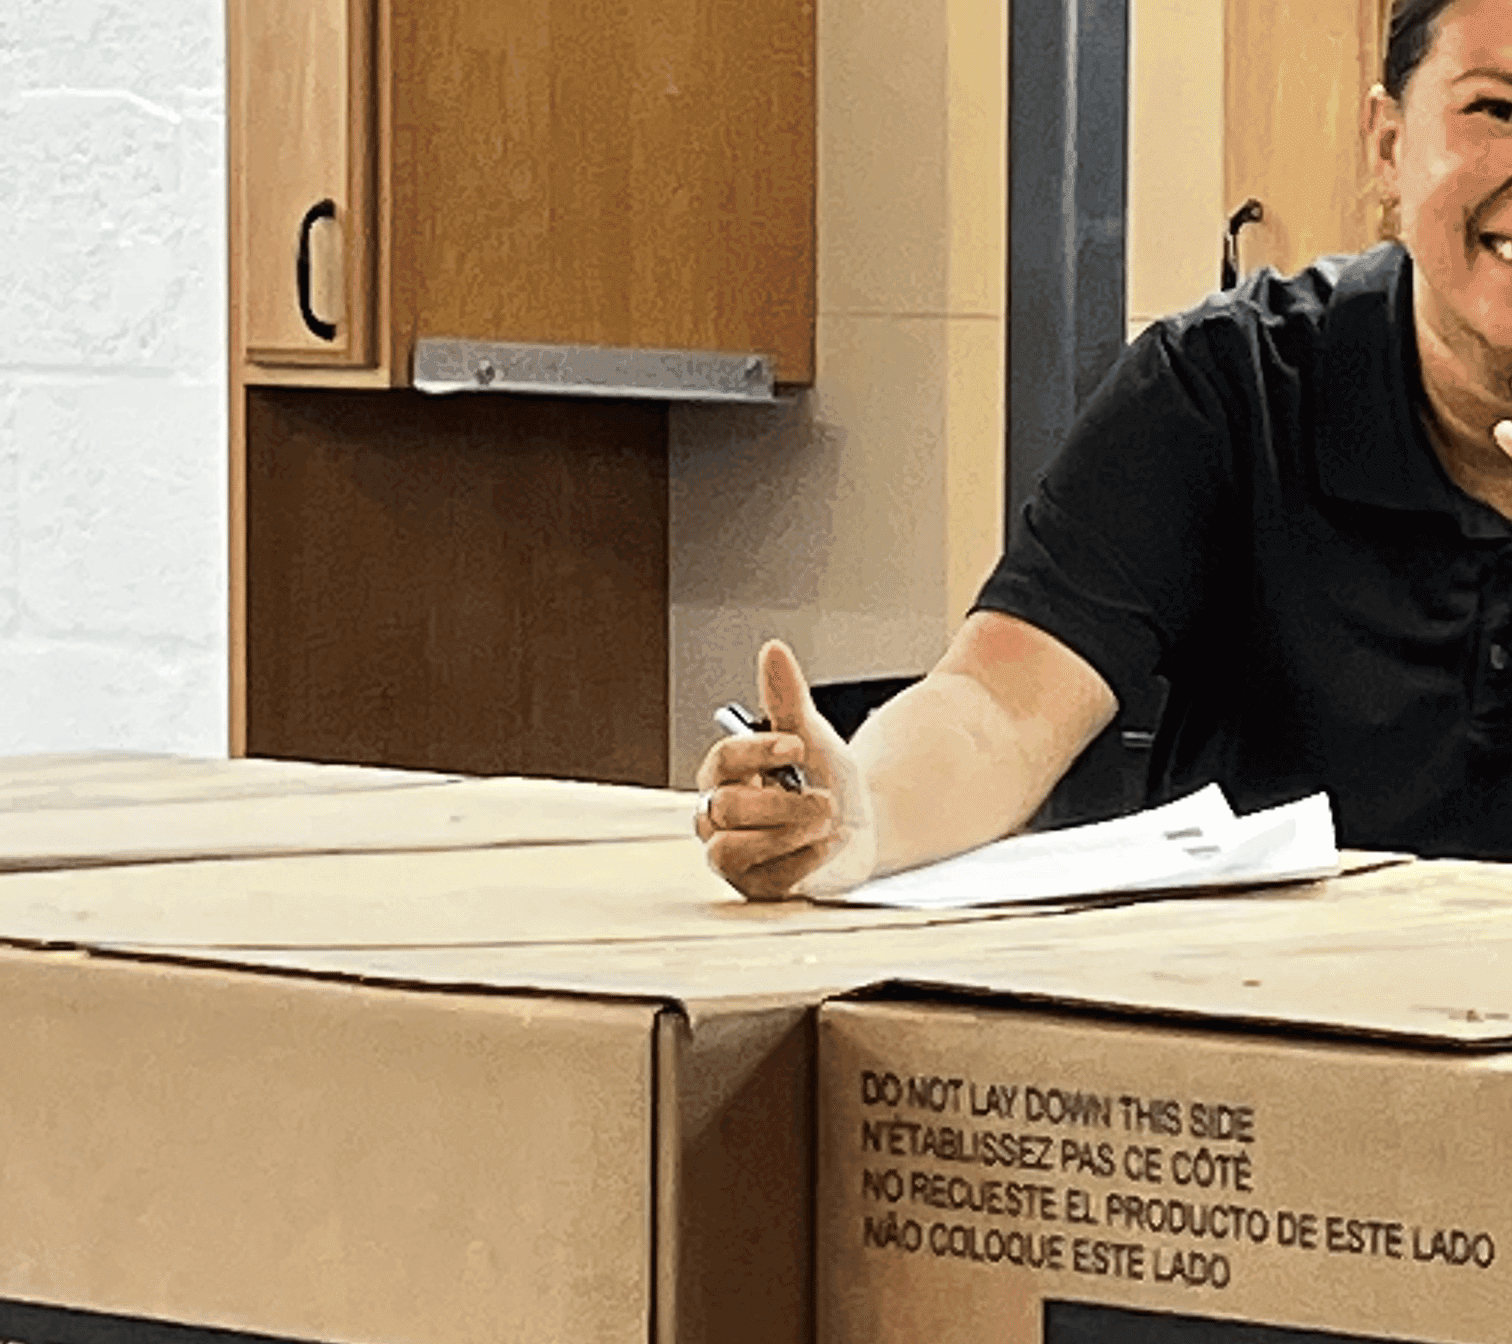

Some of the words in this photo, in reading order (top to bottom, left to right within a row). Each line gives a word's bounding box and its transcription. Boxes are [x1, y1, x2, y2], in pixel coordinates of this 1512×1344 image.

[861, 1070, 901, 1107] DO
[908, 1077, 963, 1113] NOT
[970, 1082, 1018, 1119] LAY
[1024, 1087, 1111, 1128] DOWN
[1118, 1096, 1183, 1136] THIS
[1190, 1102, 1255, 1142] SIDE
[1060, 1139, 1116, 1176] PAS
[1123, 1145, 1162, 1184] CE
[862, 1168, 902, 1204] NO
[1067, 1188, 1099, 1225] EL
[1106, 1193, 1270, 1242] PRODUCTO
[1277, 1211, 1318, 1250] DE
[1326, 1217, 1404, 1260] ESTE
[1412, 1226, 1495, 1269] LADO
[929, 1221, 1066, 1270] COLOQUE
[1073, 1238, 1145, 1281] ESTE
[1154, 1251, 1231, 1289] LADO
